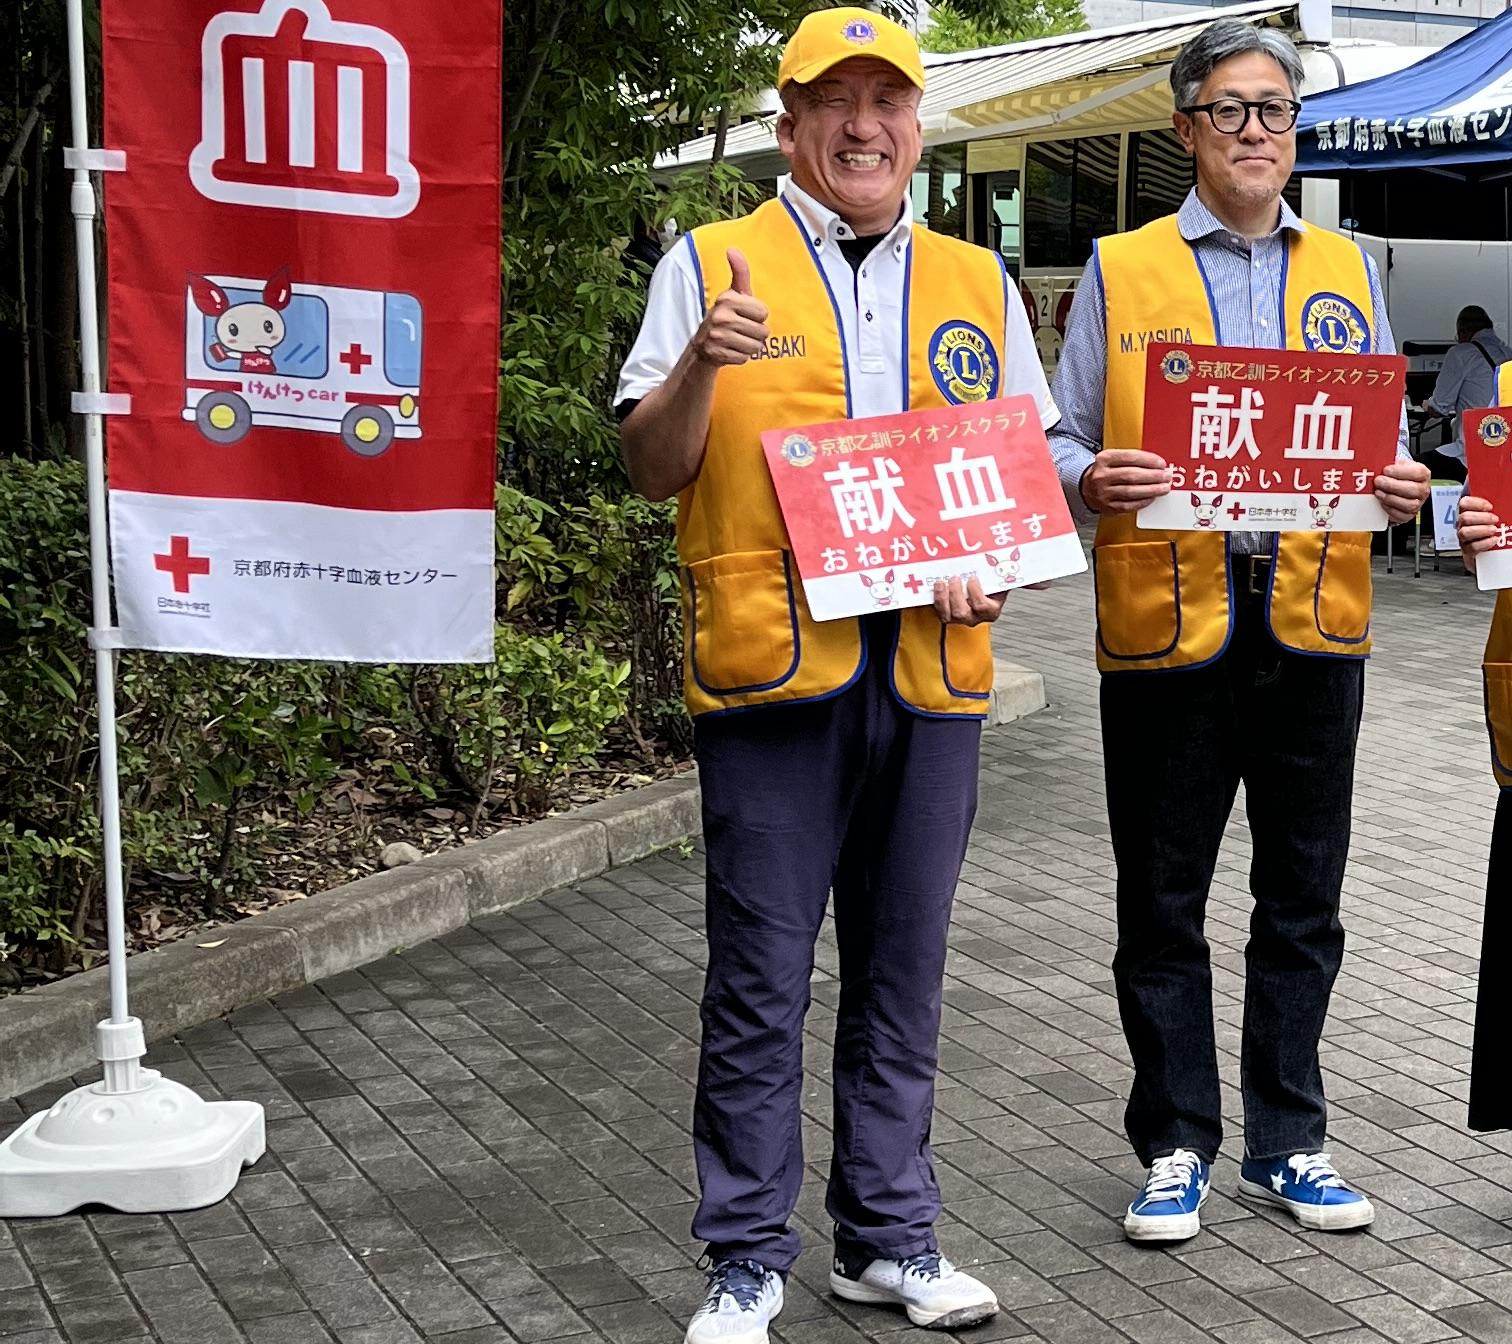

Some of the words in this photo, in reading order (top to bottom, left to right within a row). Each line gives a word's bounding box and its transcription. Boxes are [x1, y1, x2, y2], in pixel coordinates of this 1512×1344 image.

[1041, 294, 1049, 317] 2
[946, 330, 983, 350] LIONS
[1326, 319, 1343, 345] L
[958, 350, 978, 380] L
[1196, 359, 1396, 387] 京都乙訓ライオンズクラブ
[247, 380, 304, 402] けんけつ
[308, 389, 339, 403] car
[818, 411, 1028, 457] 京都乙訓ライオンズクラブ
[1190, 384, 1356, 461] 献血
[1168, 462, 1375, 492] おねがいします
[823, 446, 1017, 539] 献血
[820, 512, 1047, 574] おねがいします
[233, 559, 459, 587] 京都府赤十字血液センター
